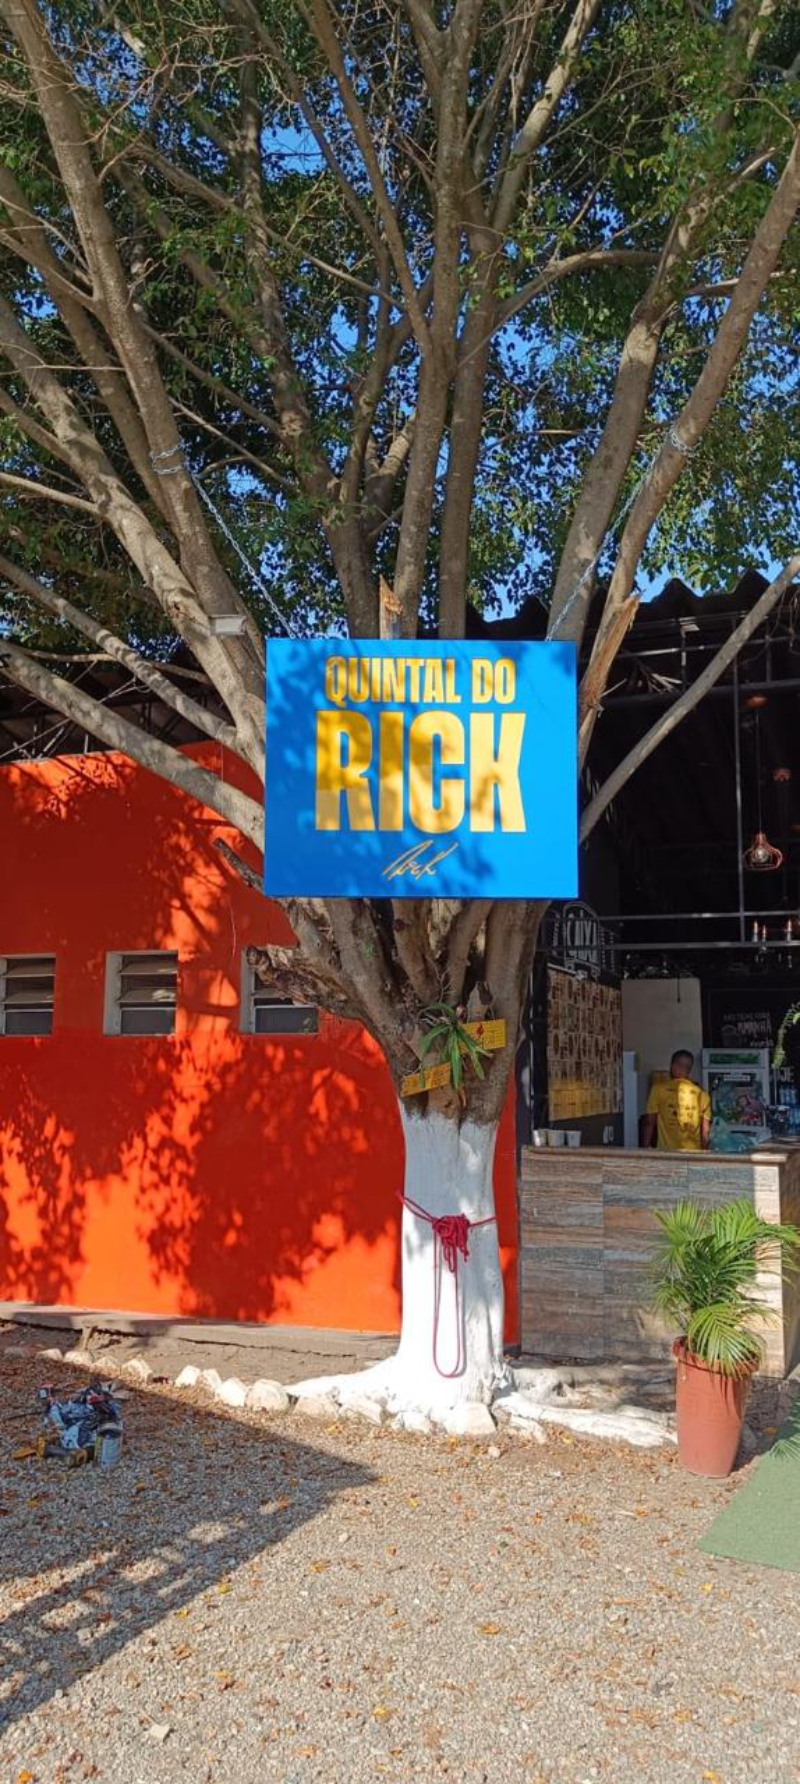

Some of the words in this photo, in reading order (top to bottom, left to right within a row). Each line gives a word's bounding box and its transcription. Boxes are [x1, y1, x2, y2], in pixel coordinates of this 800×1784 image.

[325, 656, 462, 708] QUINTAL
[471, 658, 516, 704] DO
[315, 710, 527, 834] RICK
